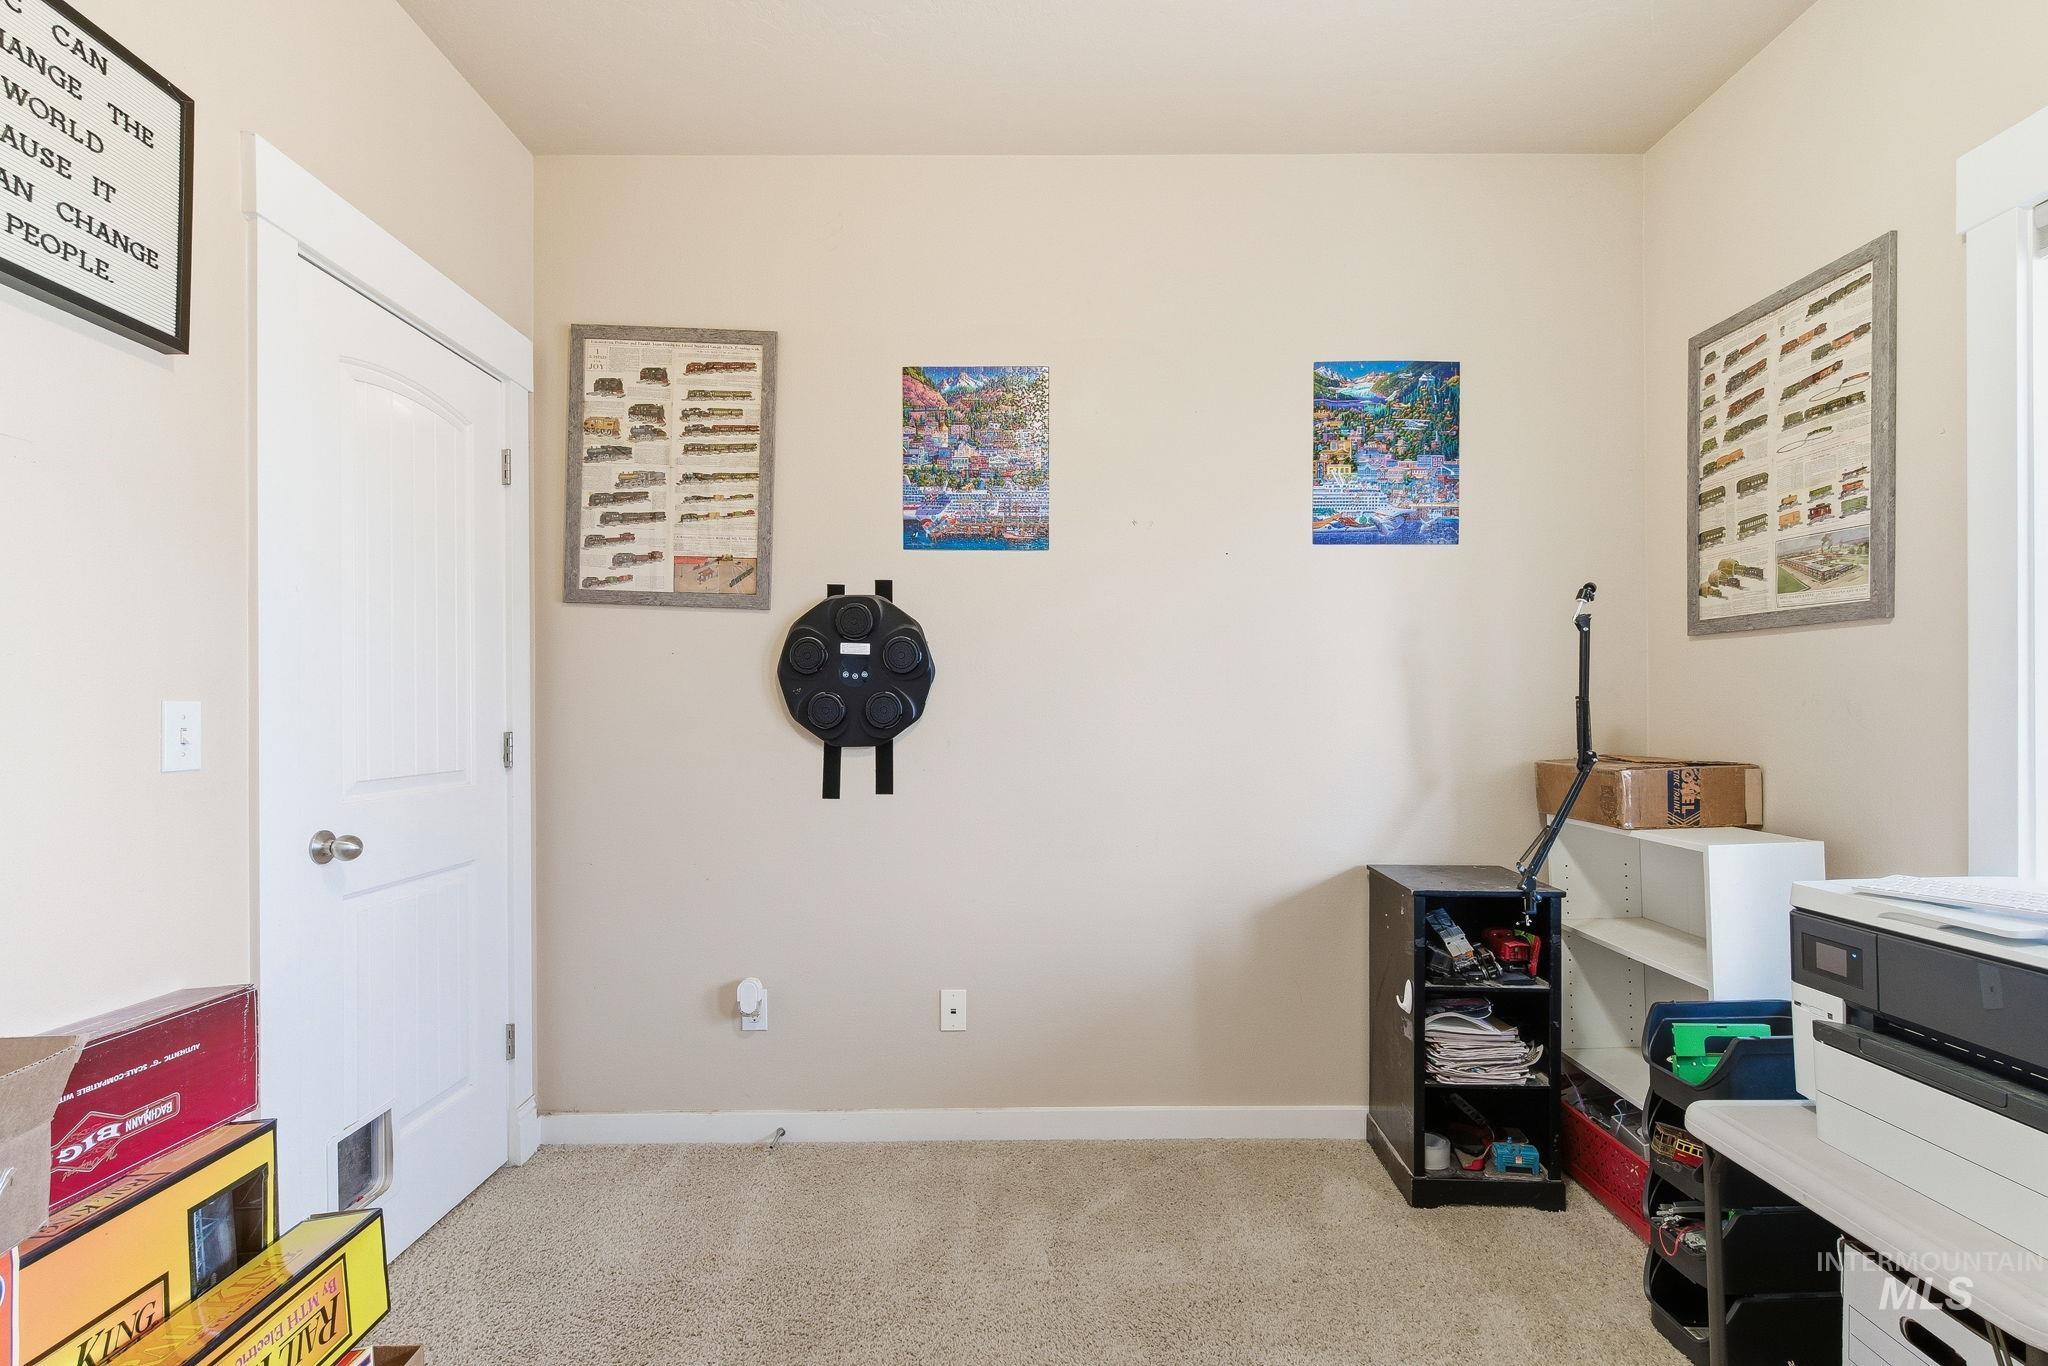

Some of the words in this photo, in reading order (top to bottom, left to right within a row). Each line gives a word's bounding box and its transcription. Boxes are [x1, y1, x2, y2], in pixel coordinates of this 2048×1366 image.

[51, 25, 108, 77] CAN
[0, 74, 105, 154] WORLD
[107, 101, 154, 149] THE
[0, 123, 72, 180] AUSE
[91, 175, 117, 204] IT
[4, 211, 115, 284] PEOPLE.
[56, 201, 159, 270] CHANGE
[163, 1042, 201, 1063] AUTHENTIC
[76, 1063, 148, 1097] SCALE-COMPATIBLE
[124, 1101, 173, 1133] BACHMANN
[56, 1122, 124, 1164] BIG
[286, 1291, 321, 1330] MTH
[321, 1276, 337, 1297] By
[76, 1300, 156, 1366] KING
[234, 1322, 284, 1366] Electric
[278, 1292, 340, 1366] RAIL
